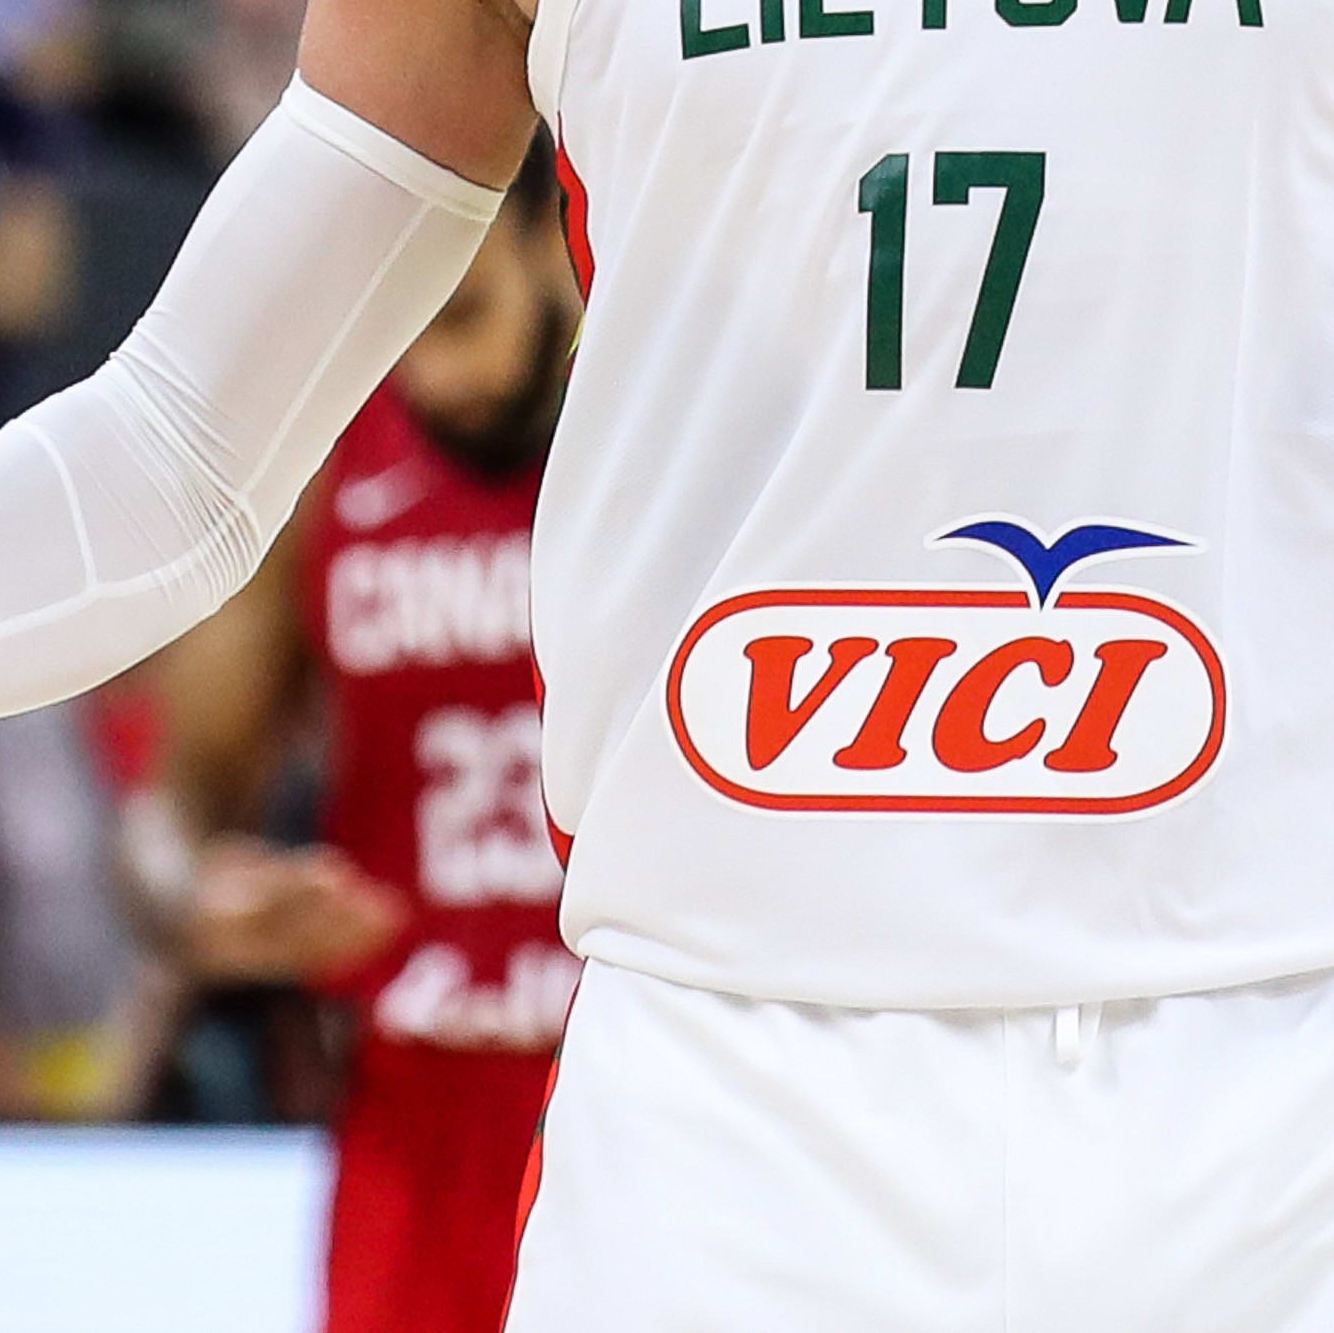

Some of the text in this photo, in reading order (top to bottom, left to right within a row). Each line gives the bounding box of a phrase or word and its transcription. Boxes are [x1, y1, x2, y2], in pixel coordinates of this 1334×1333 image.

[857, 150, 1047, 391] 17
[327, 535, 533, 671] CANA
[743, 635, 1168, 773] VICI
